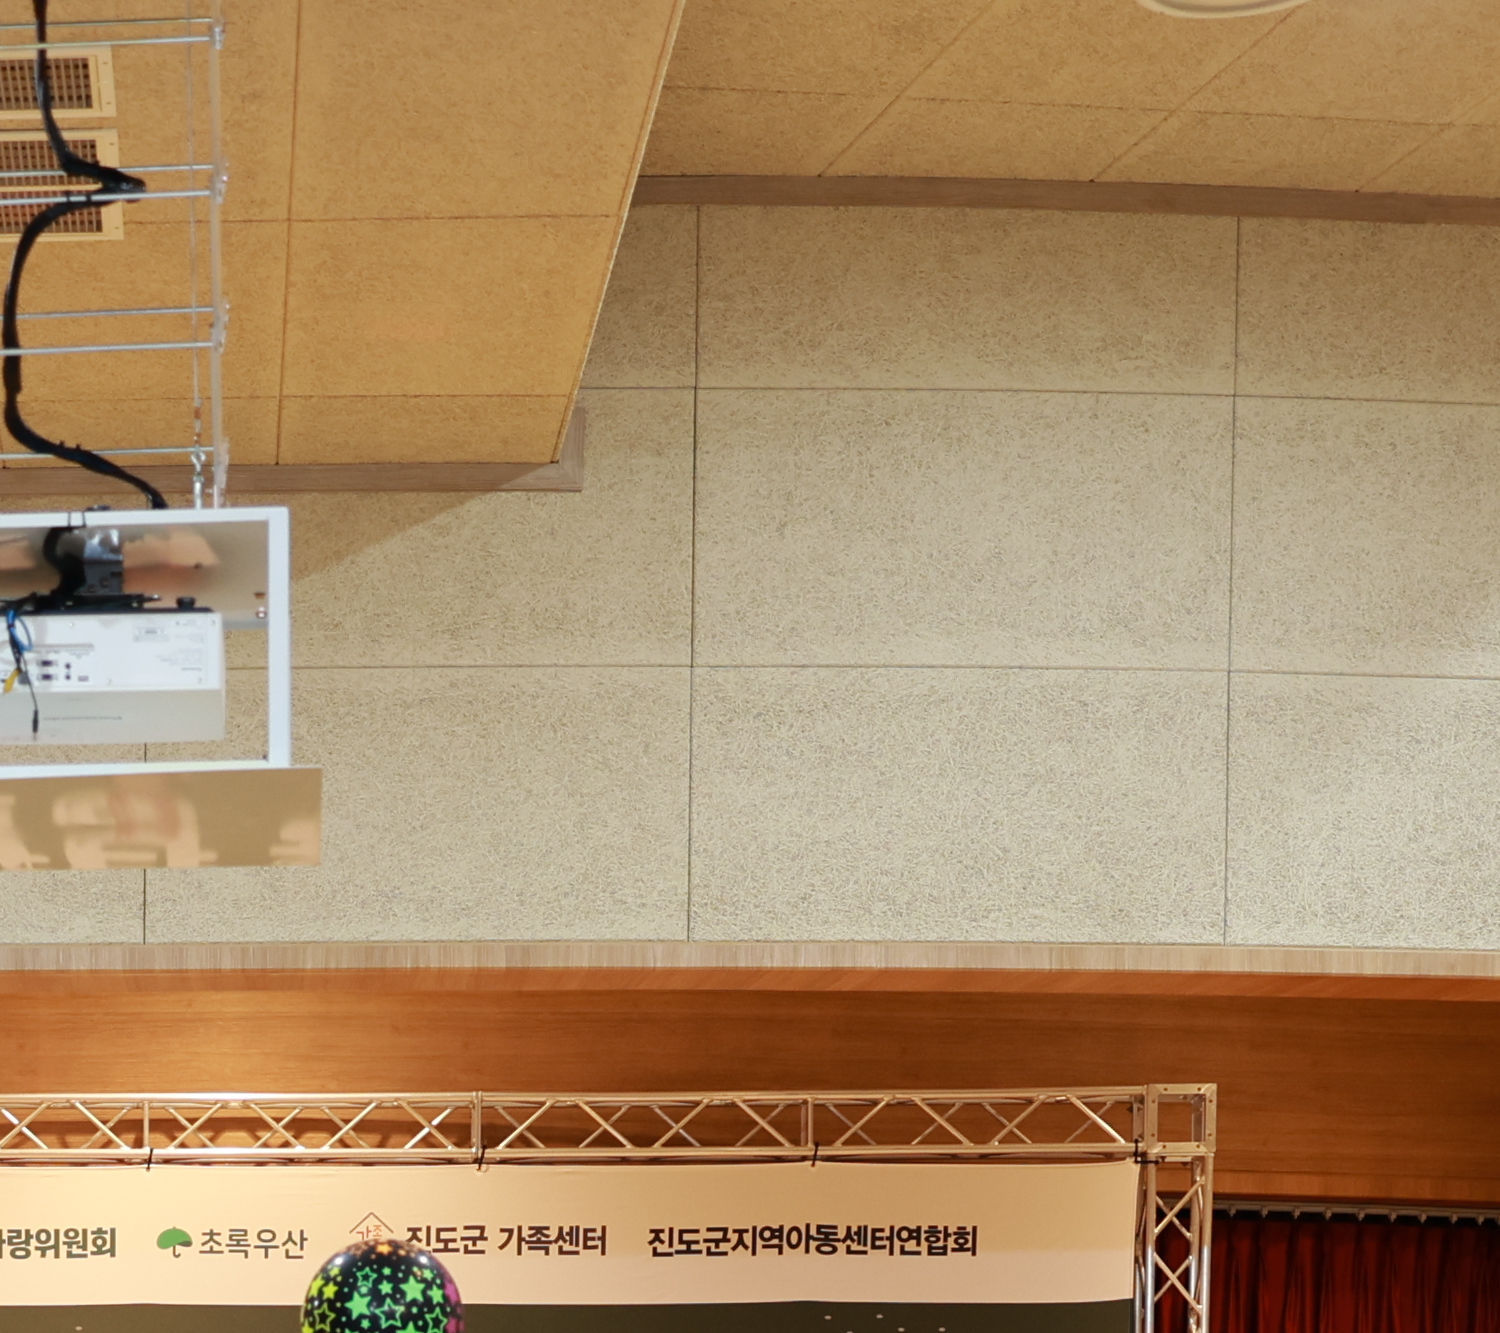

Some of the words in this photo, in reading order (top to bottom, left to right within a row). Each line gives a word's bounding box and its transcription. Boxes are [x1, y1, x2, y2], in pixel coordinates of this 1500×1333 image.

[198, 1228, 308, 1260] 초록우산
[405, 1225, 488, 1255] 진도군
[497, 1224, 608, 1256] 가족센터
[646, 1223, 979, 1258] 진도군지역아동센터연합회
